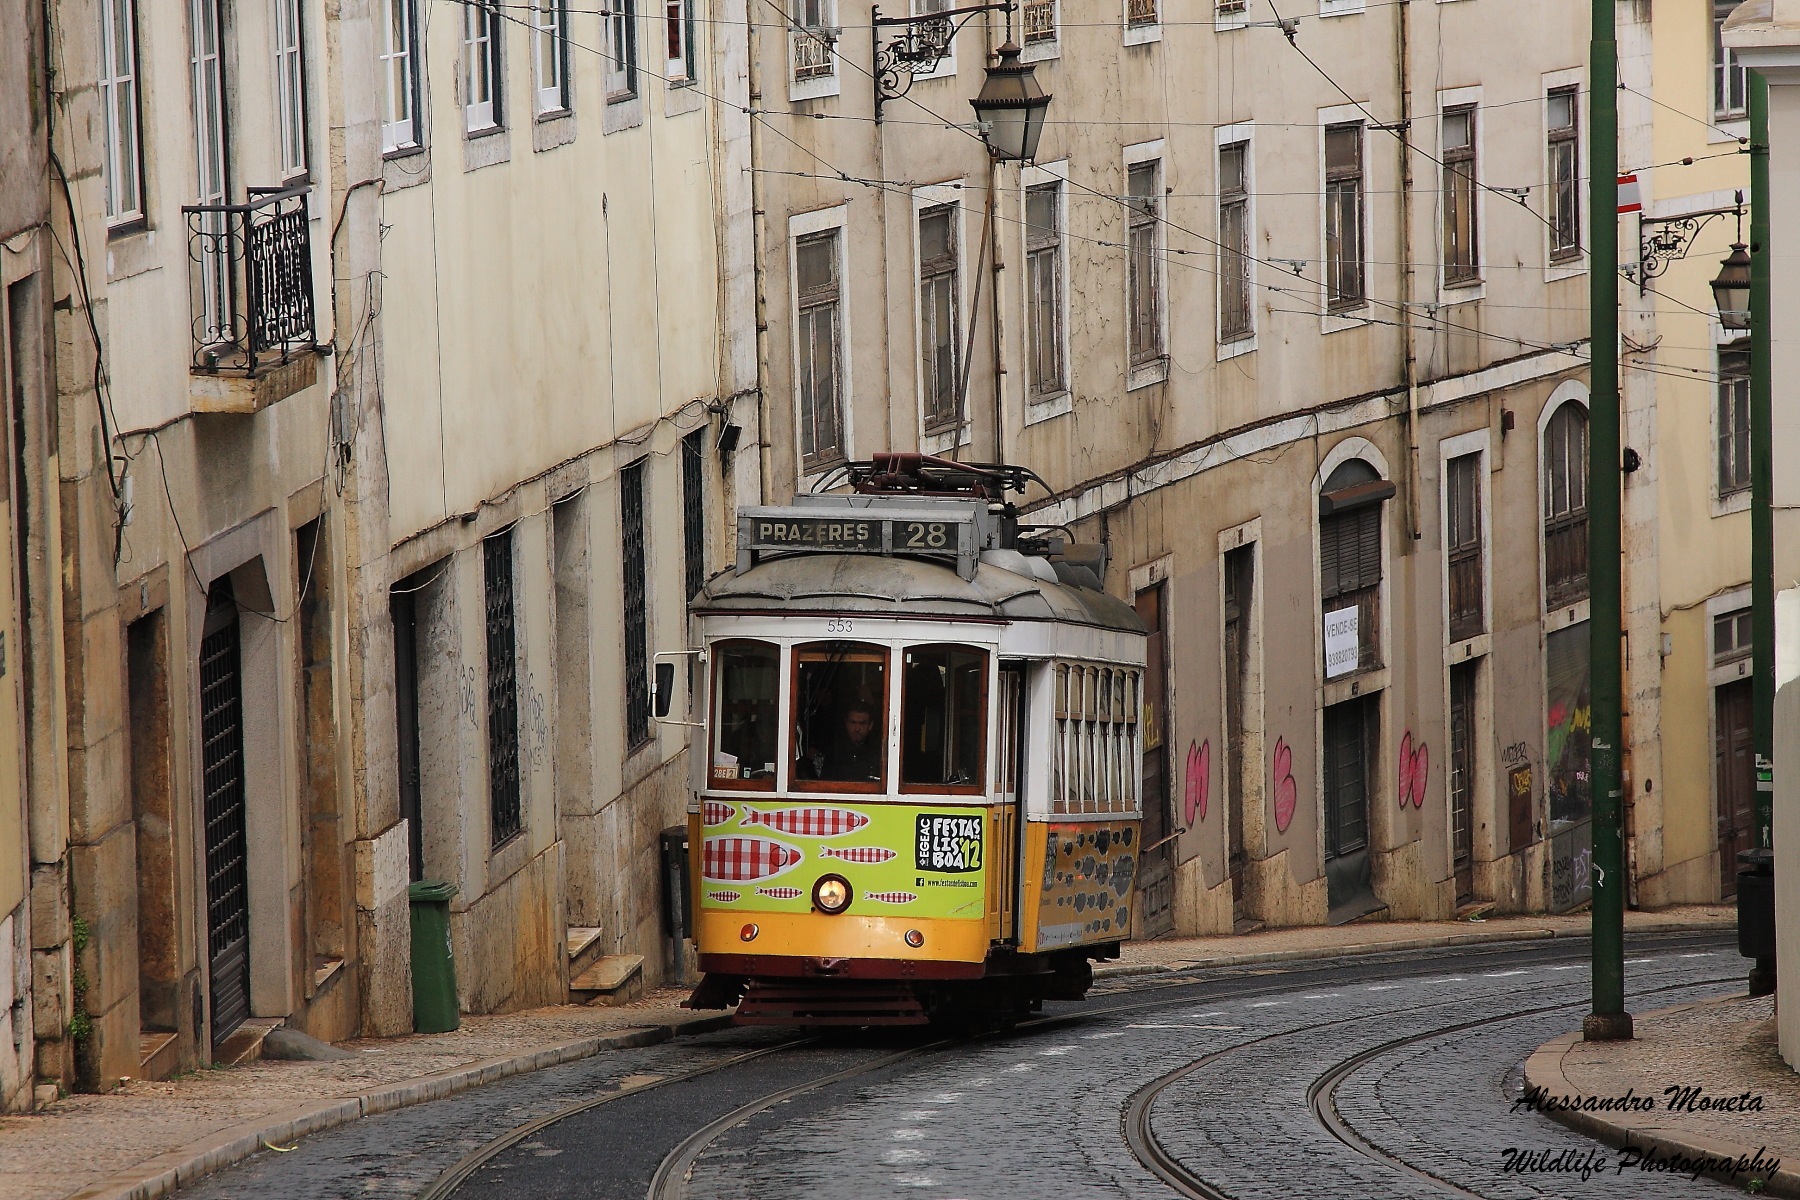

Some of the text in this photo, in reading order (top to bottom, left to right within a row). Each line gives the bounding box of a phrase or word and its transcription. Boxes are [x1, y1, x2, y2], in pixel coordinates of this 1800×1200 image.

[759, 523, 869, 541] PRAZERES
[906, 522, 947, 548] 28
[827, 619, 853, 633] 553
[1326, 617, 1358, 638] VENDE-SE
[920, 818, 931, 858] EGEAC
[932, 818, 981, 840] FESTAS
[932, 836, 960, 856] LIS
[932, 852, 964, 870] BOA
